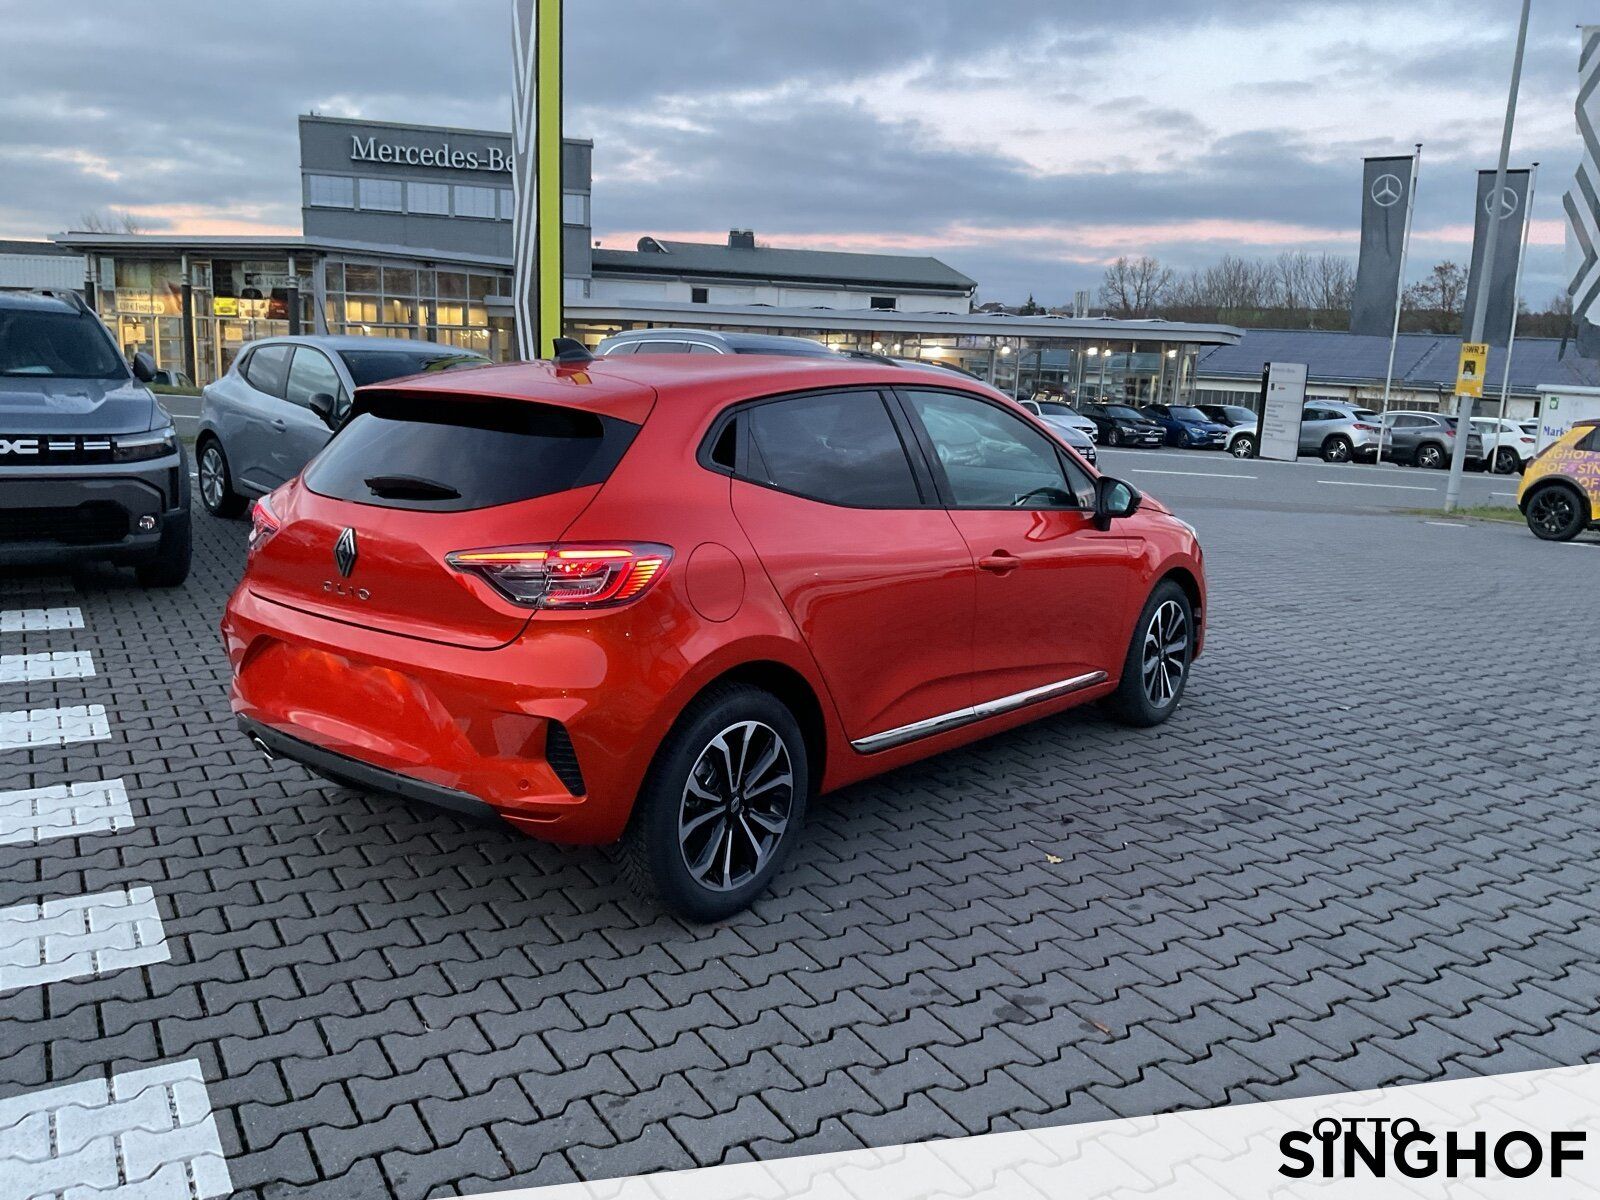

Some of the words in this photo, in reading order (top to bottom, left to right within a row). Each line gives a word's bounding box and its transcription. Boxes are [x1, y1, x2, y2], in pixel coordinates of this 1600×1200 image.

[351, 135, 513, 173] Mercedes-Be
[1544, 449, 1593, 460] NGHOF
[323, 580, 370, 600] CLIO
